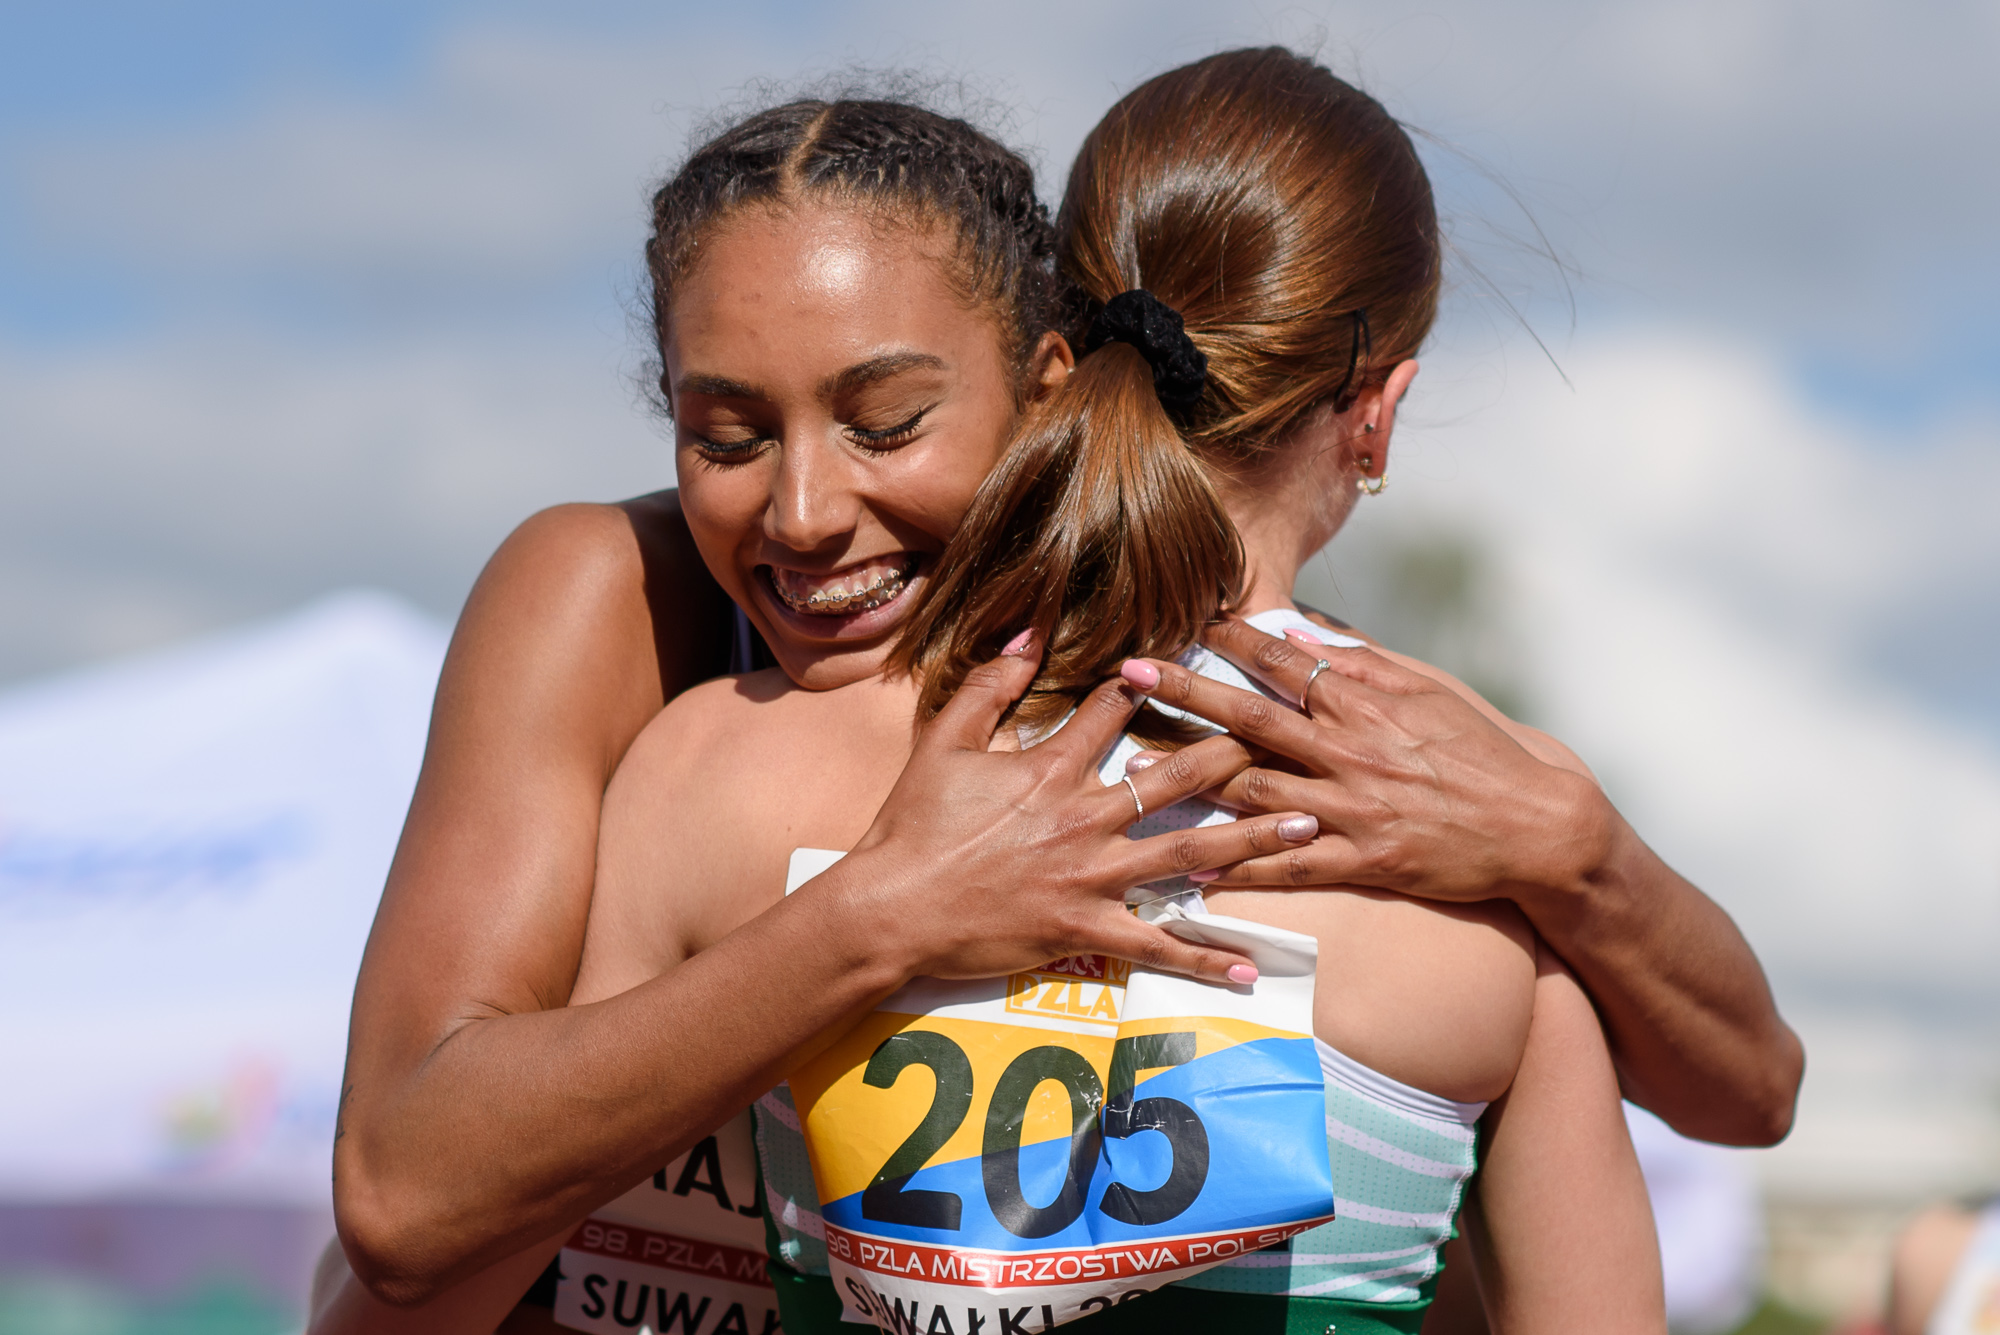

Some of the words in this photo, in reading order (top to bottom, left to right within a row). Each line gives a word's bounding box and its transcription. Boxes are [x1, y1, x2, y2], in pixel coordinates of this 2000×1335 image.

[1012, 974, 1118, 1020] PZLA
[862, 1030, 1210, 1239] 205
[582, 1224, 633, 1254] 98.
[642, 1236, 727, 1273] PZLA
[827, 1230, 857, 1261] 98.
[860, 1242, 925, 1276] PZLA
[932, 1247, 1180, 1283] MISTRZOSTWA
[1188, 1226, 1310, 1263] POLSK
